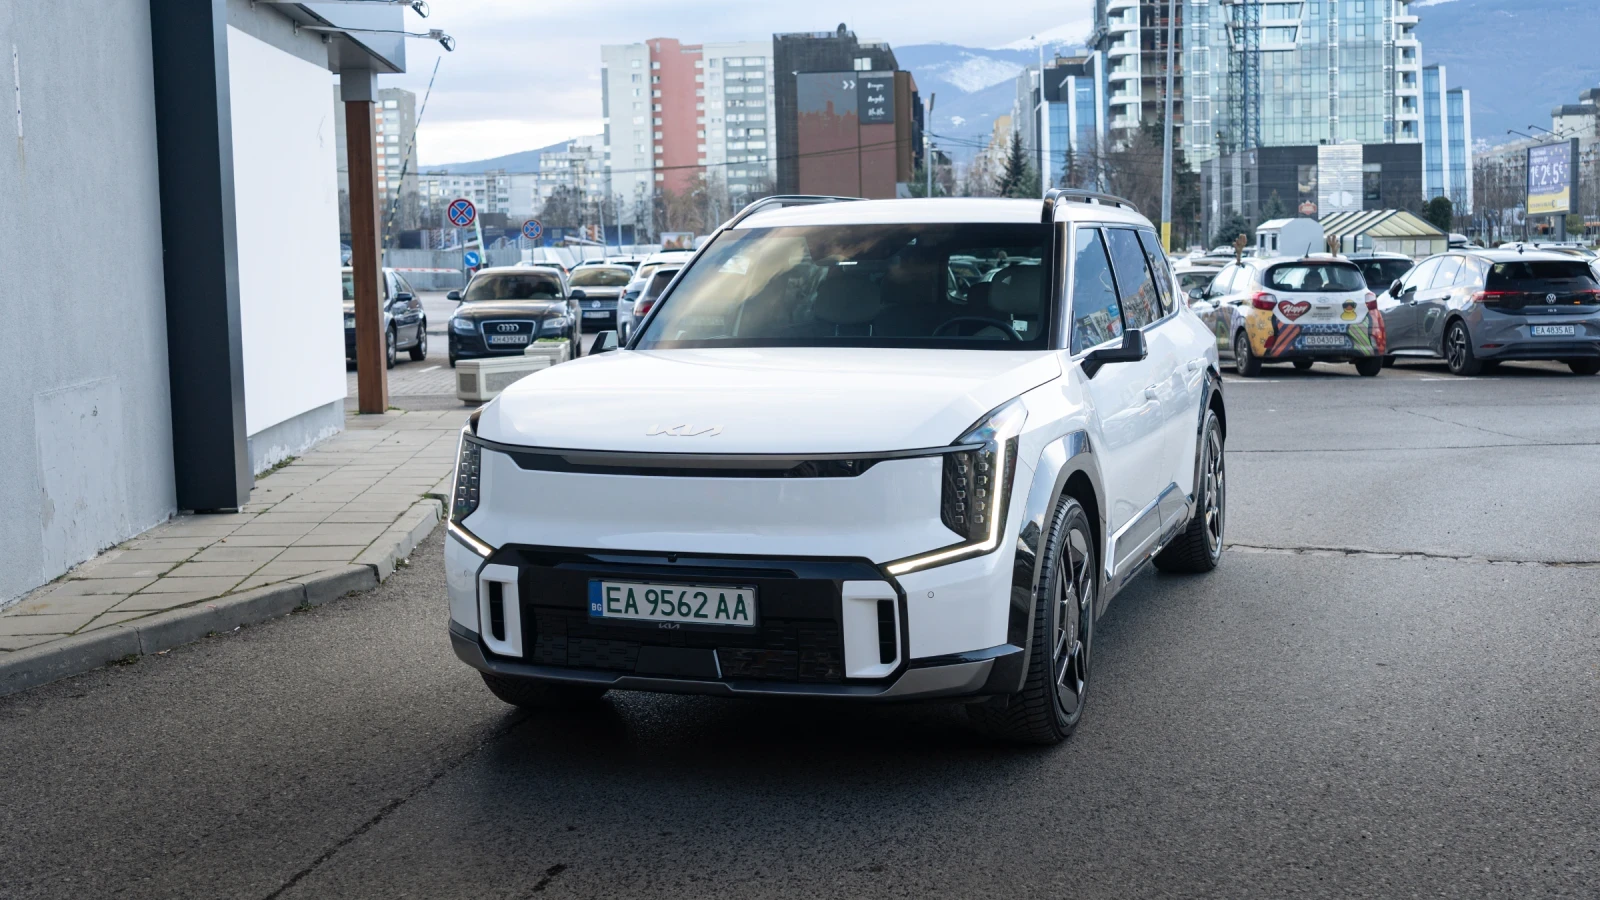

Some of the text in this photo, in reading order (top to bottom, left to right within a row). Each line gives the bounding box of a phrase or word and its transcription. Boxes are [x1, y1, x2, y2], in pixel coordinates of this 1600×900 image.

[1282, 304, 1308, 314] Happy
[646, 424, 724, 437] KIA
[591, 603, 602, 612] BG
[606, 586, 748, 621] EA 9562 AA
[658, 622, 680, 630] KIA
